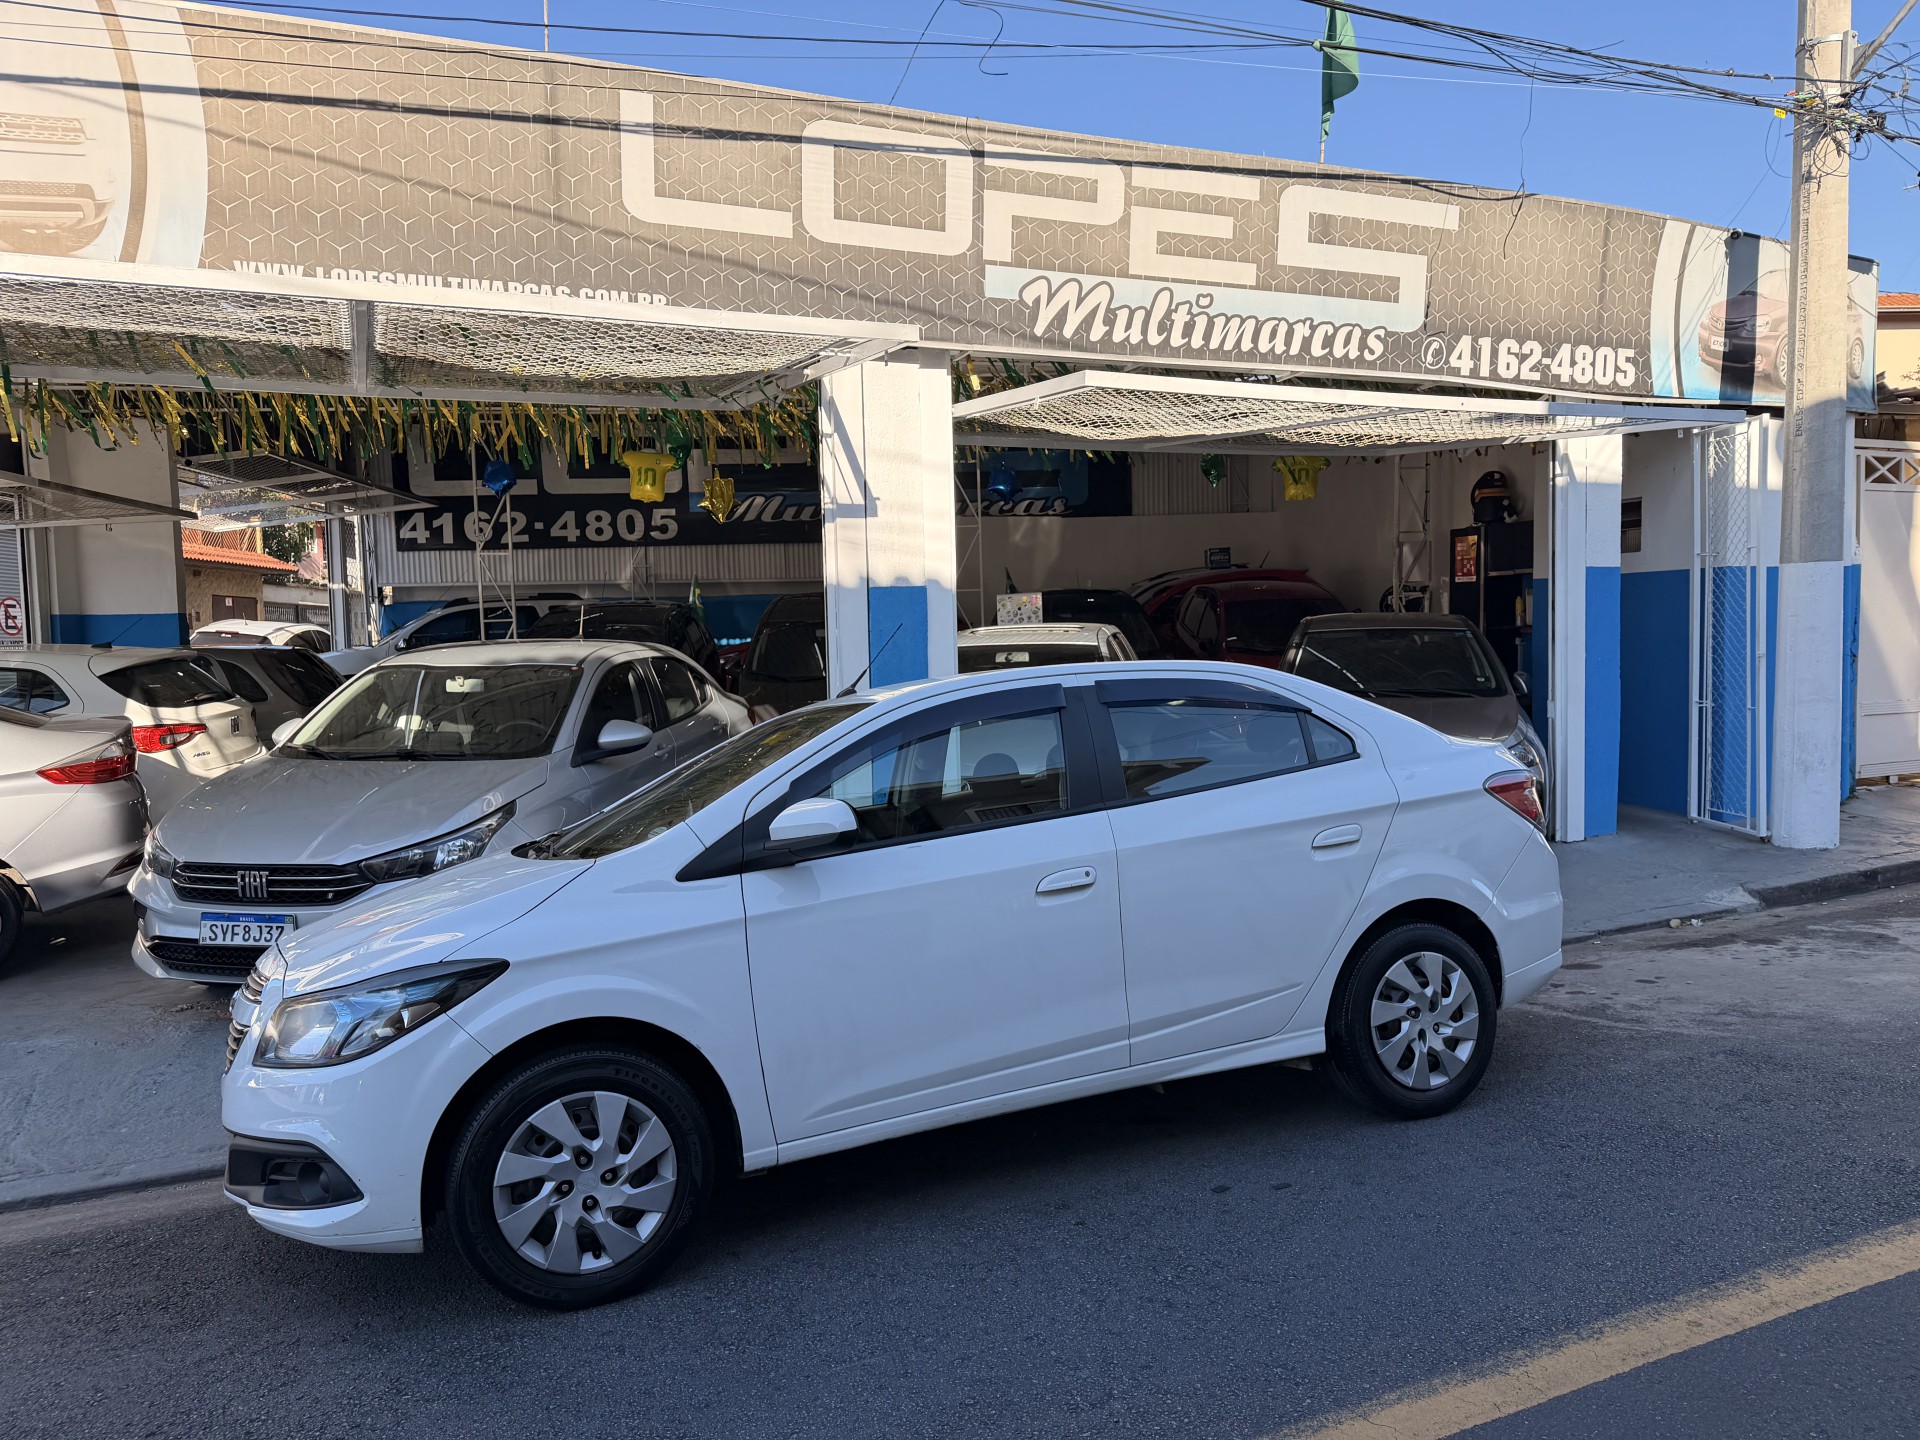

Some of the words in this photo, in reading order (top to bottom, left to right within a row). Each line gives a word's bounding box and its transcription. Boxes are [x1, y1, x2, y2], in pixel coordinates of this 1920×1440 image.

[620, 90, 1459, 332] LOPES
[1021, 277, 1387, 361] Multimarcas
[1449, 334, 1635, 388] 4162-4805
[237, 870, 269, 898] FIAT
[208, 924, 285, 944] SYF8J37
